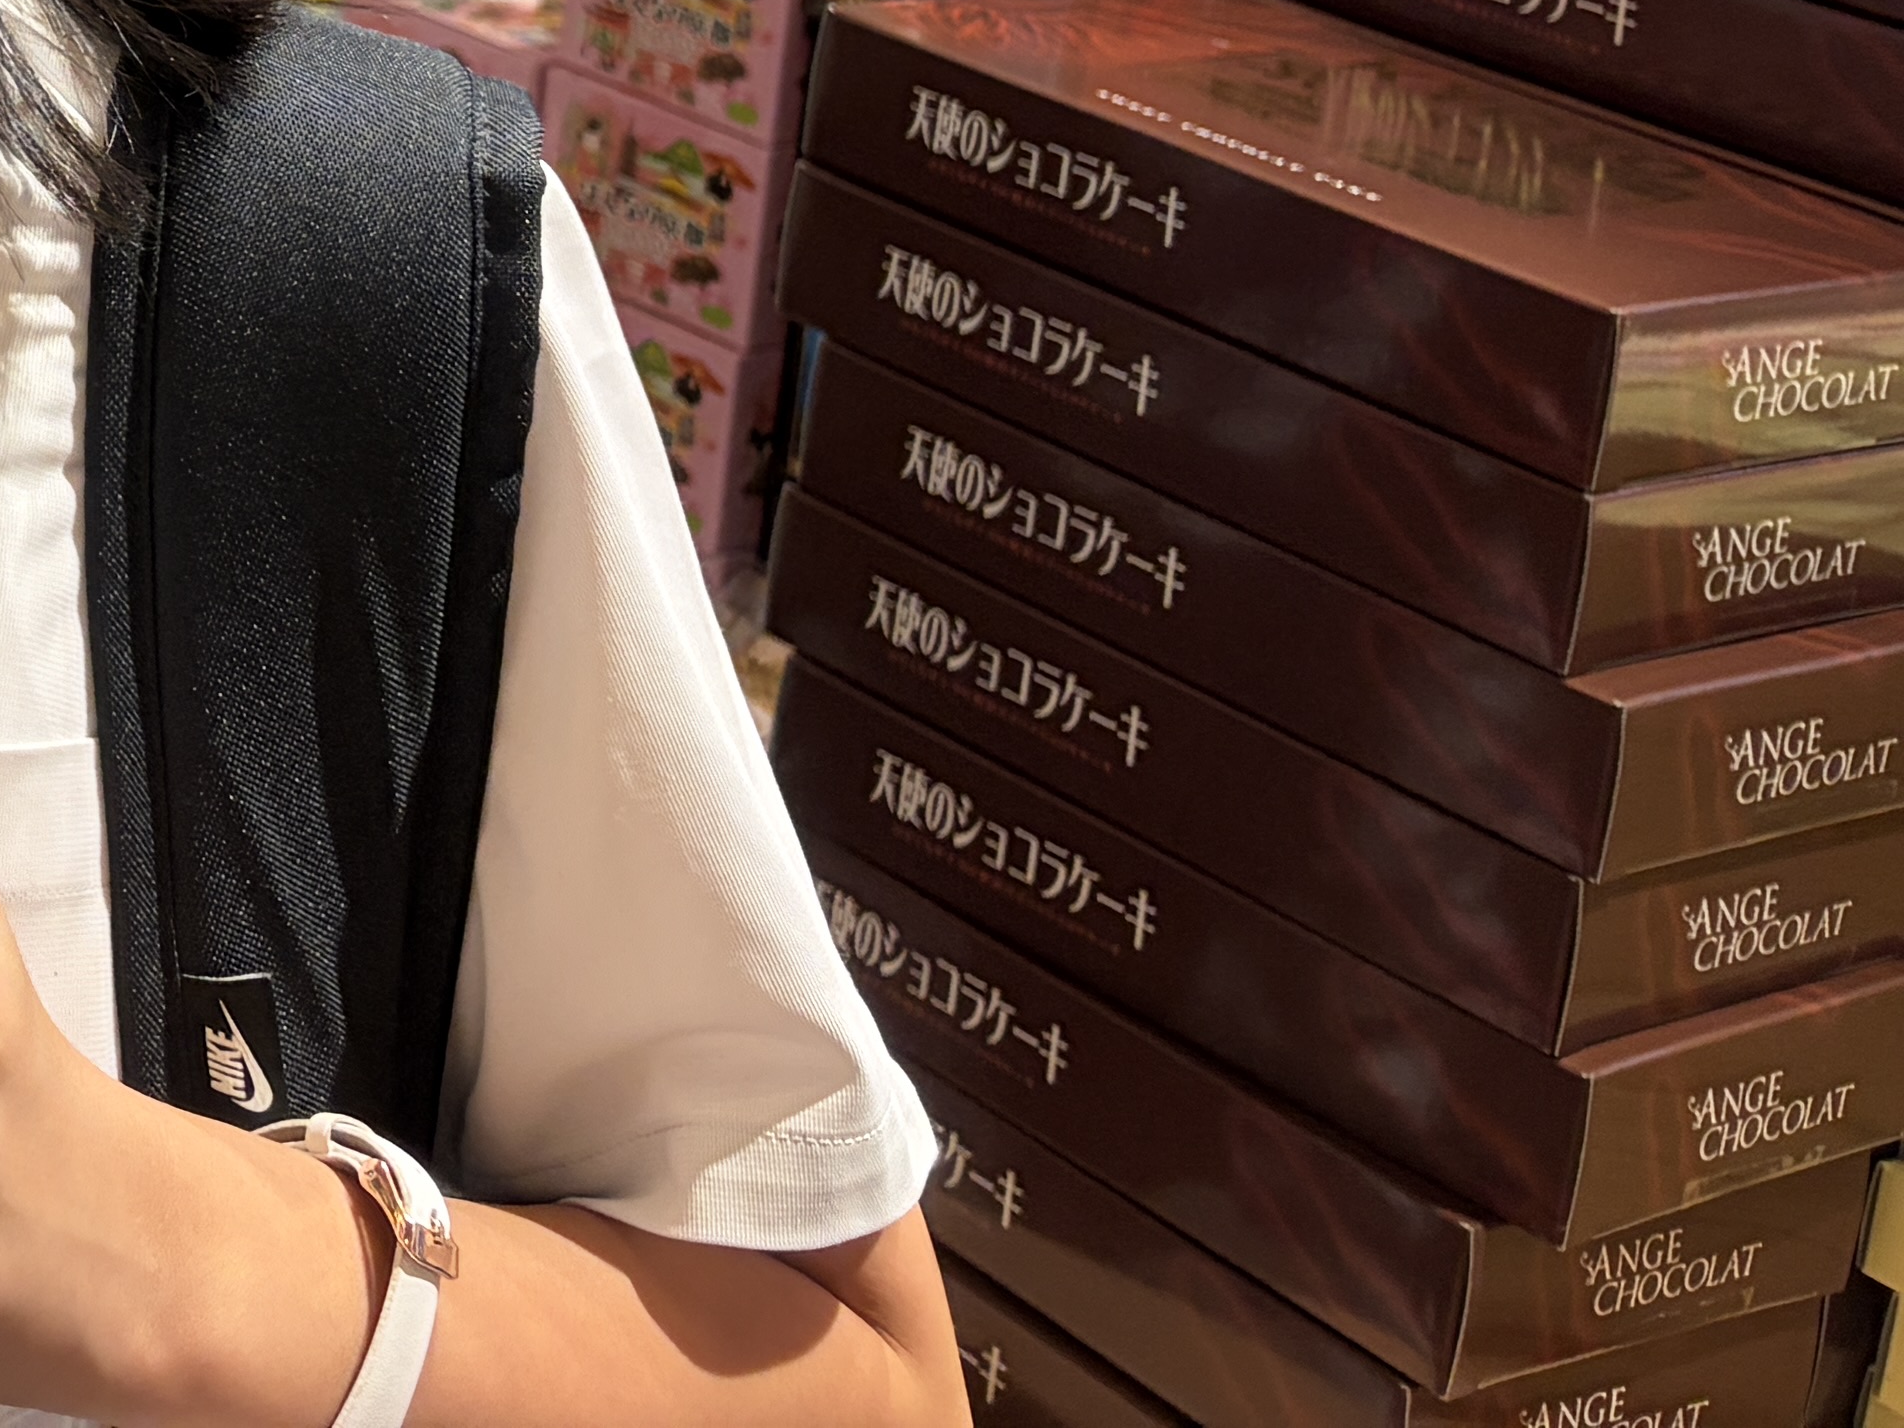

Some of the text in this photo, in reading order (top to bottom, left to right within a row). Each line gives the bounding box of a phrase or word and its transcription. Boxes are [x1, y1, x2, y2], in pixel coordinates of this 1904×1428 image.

[905, 85, 1190, 249] 天使のショコラケーキ
[877, 244, 1161, 416] 天使のショコラケーキ
[1733, 363, 1900, 423] CHOCOLAT
[898, 424, 1188, 610] 天使のショコラケーキ
[1704, 539, 1867, 603] CHOCOLAT
[864, 574, 1151, 768] 天使のショコラケーキ
[1736, 738, 1898, 807] CHOCOLAT
[868, 747, 1159, 952] 天使のショコラケーキ
[1694, 900, 1854, 974] CHOCOLAT
[203, 1025, 245, 1099] NIKE
[1699, 1084, 1856, 1163] CHOCOLAT
[1593, 1242, 1764, 1318] CHOCOLAT
